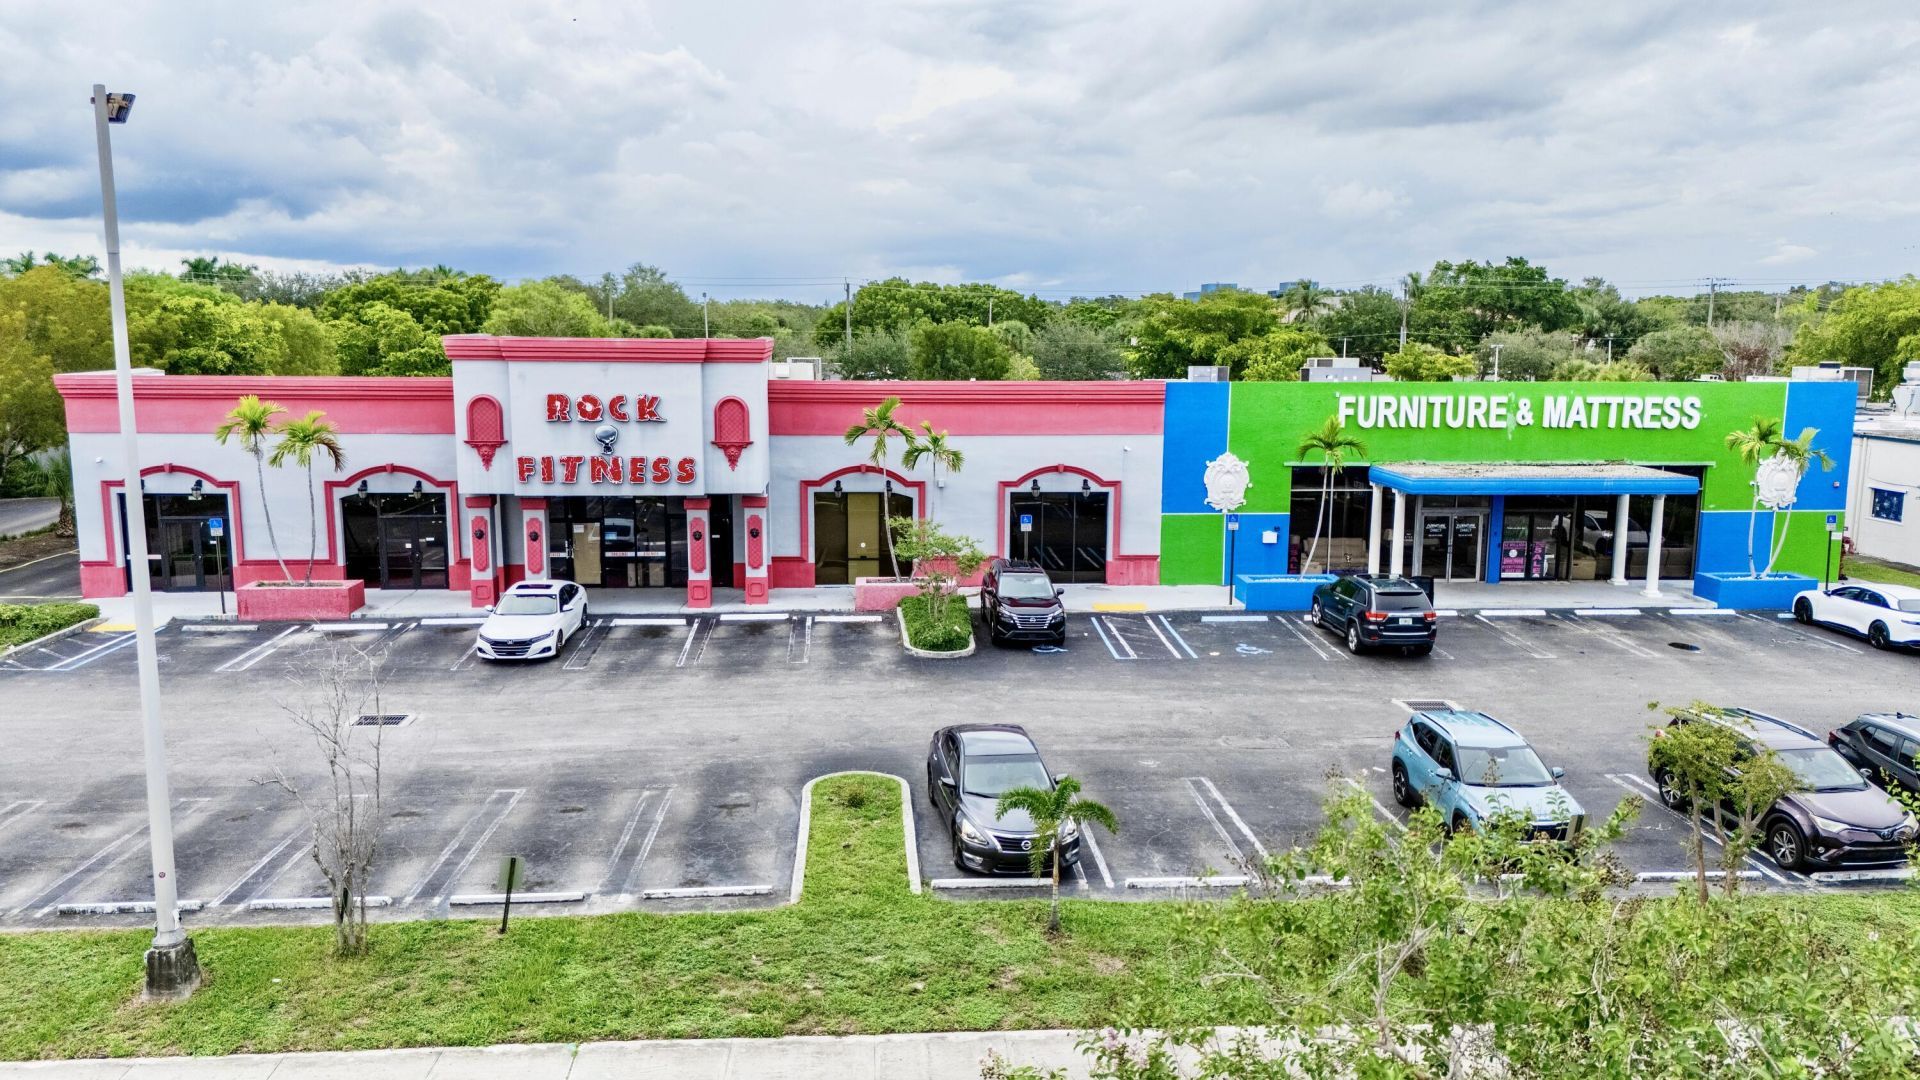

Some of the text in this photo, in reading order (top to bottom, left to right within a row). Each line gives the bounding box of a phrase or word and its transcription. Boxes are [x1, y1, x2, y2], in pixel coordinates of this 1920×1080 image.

[546, 394, 667, 422] ROCK
[1338, 395, 1701, 429] FURNITURE & MATTRESS
[517, 456, 696, 484] FITNESS
